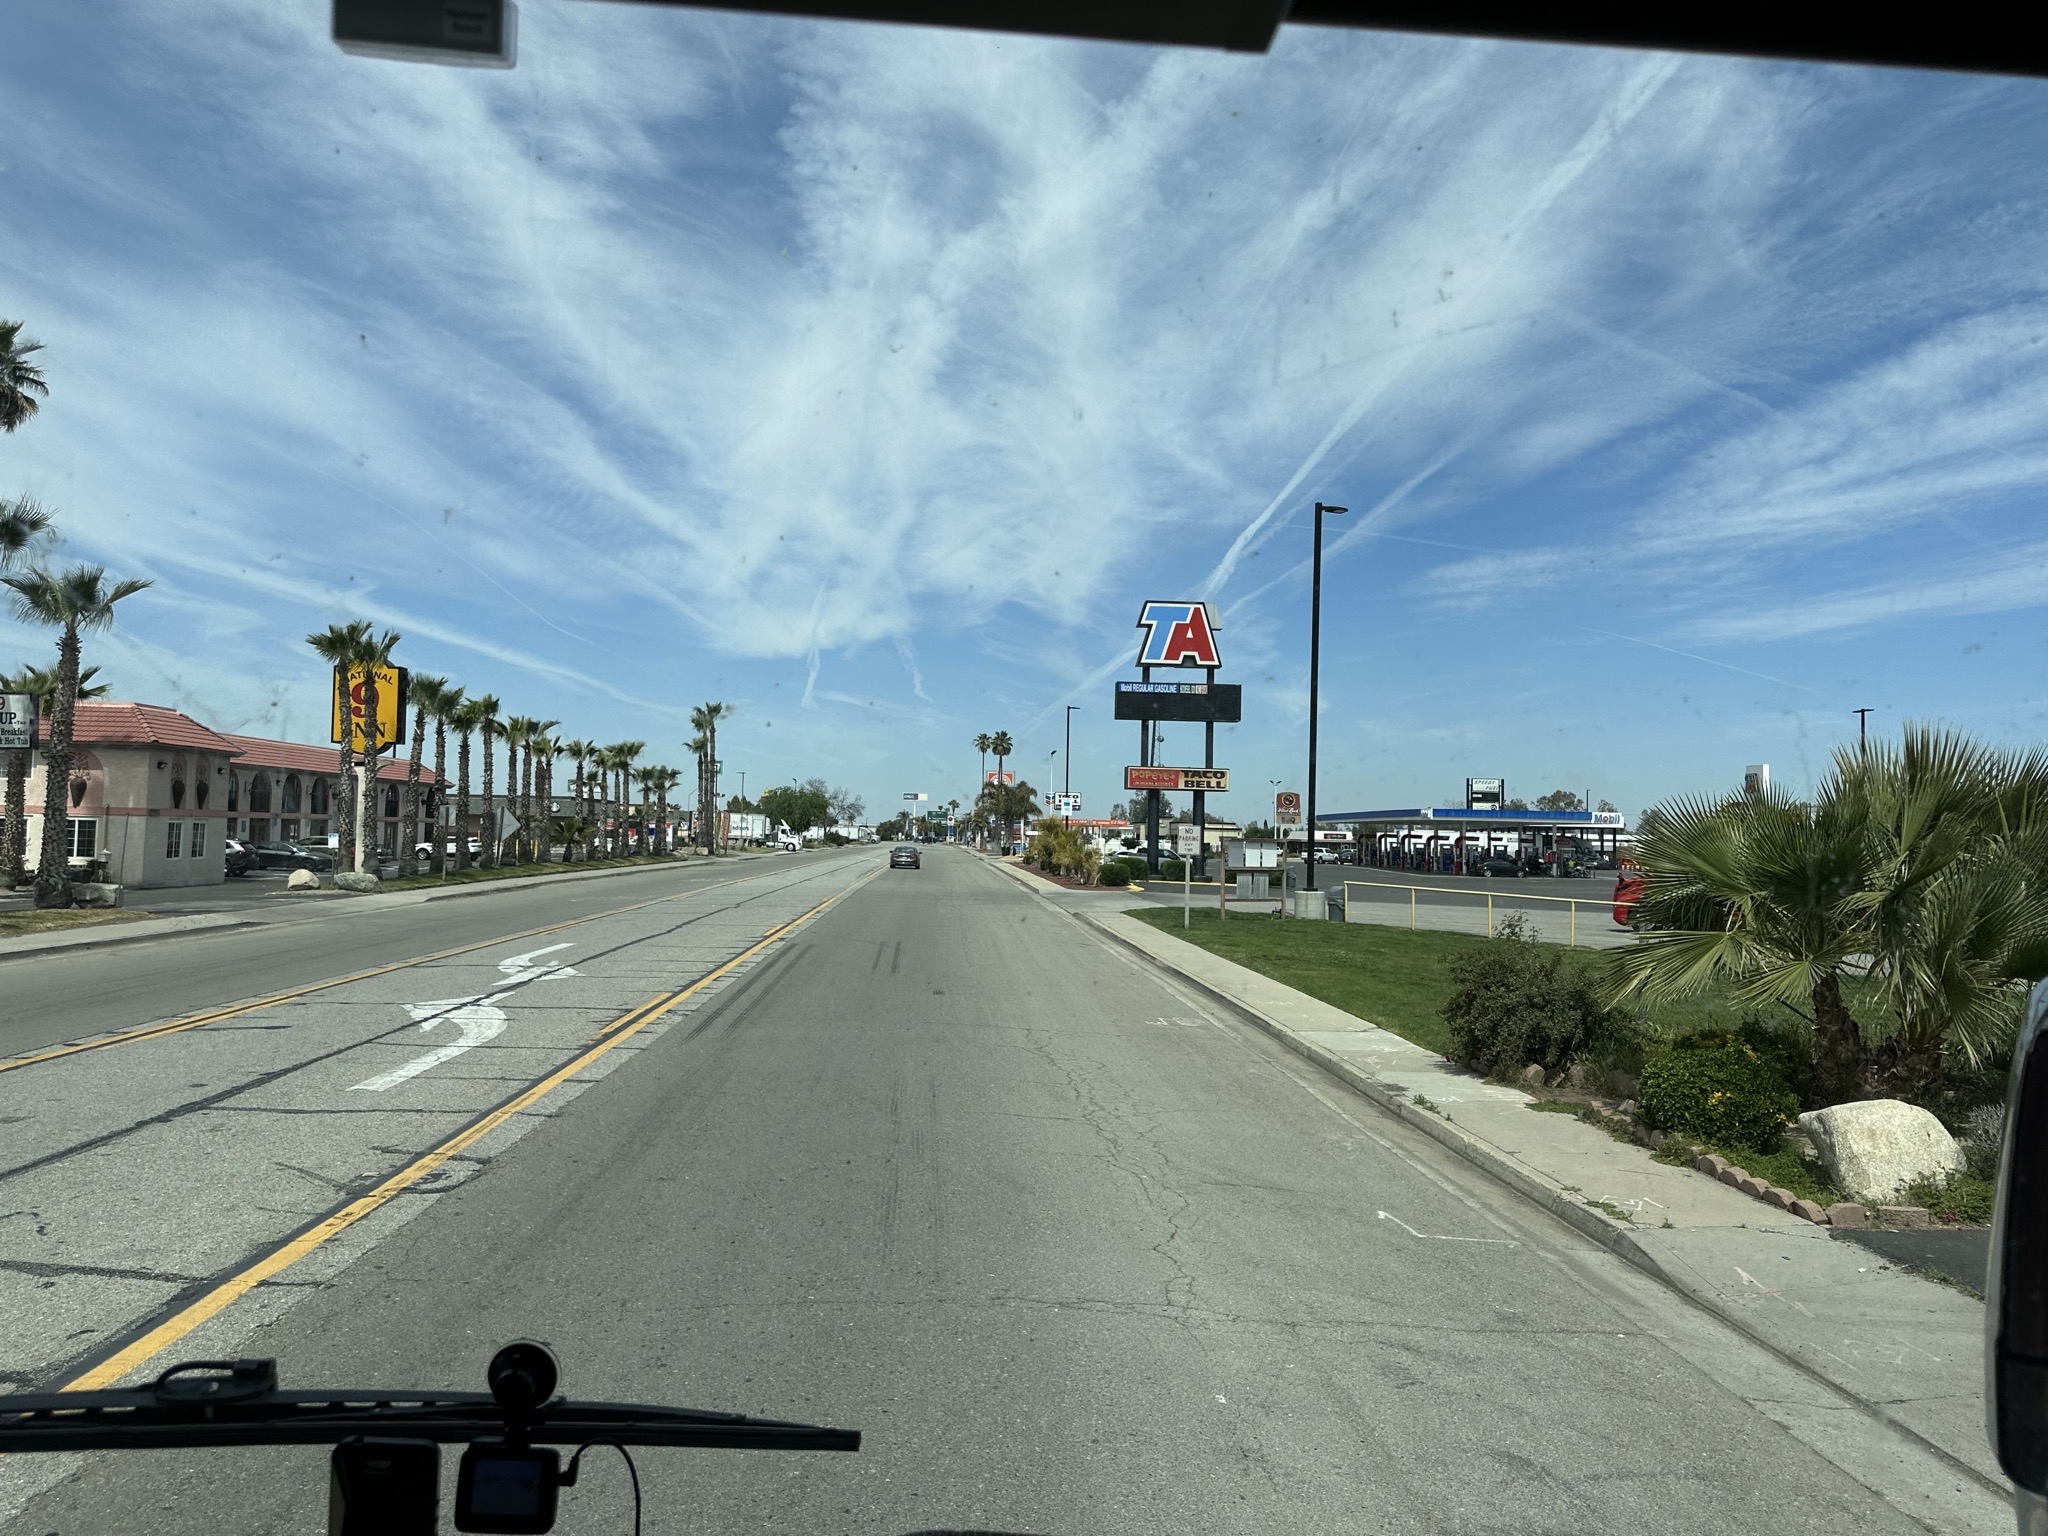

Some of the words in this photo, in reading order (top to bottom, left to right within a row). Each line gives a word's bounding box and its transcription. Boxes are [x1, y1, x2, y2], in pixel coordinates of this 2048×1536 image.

[1141, 603, 1219, 664] TA
[1133, 683, 1154, 692] REGULAR
[1155, 684, 1177, 693] GASOLINE
[351, 682, 380, 718] 9
[1, 728, 28, 736] Breakfast
[4, 737, 16, 745] Hot
[17, 737, 29, 745] Tub
[1181, 770, 1226, 779] TACO
[1184, 780, 1226, 789] BELL
[1594, 814, 1620, 824] Mobil
